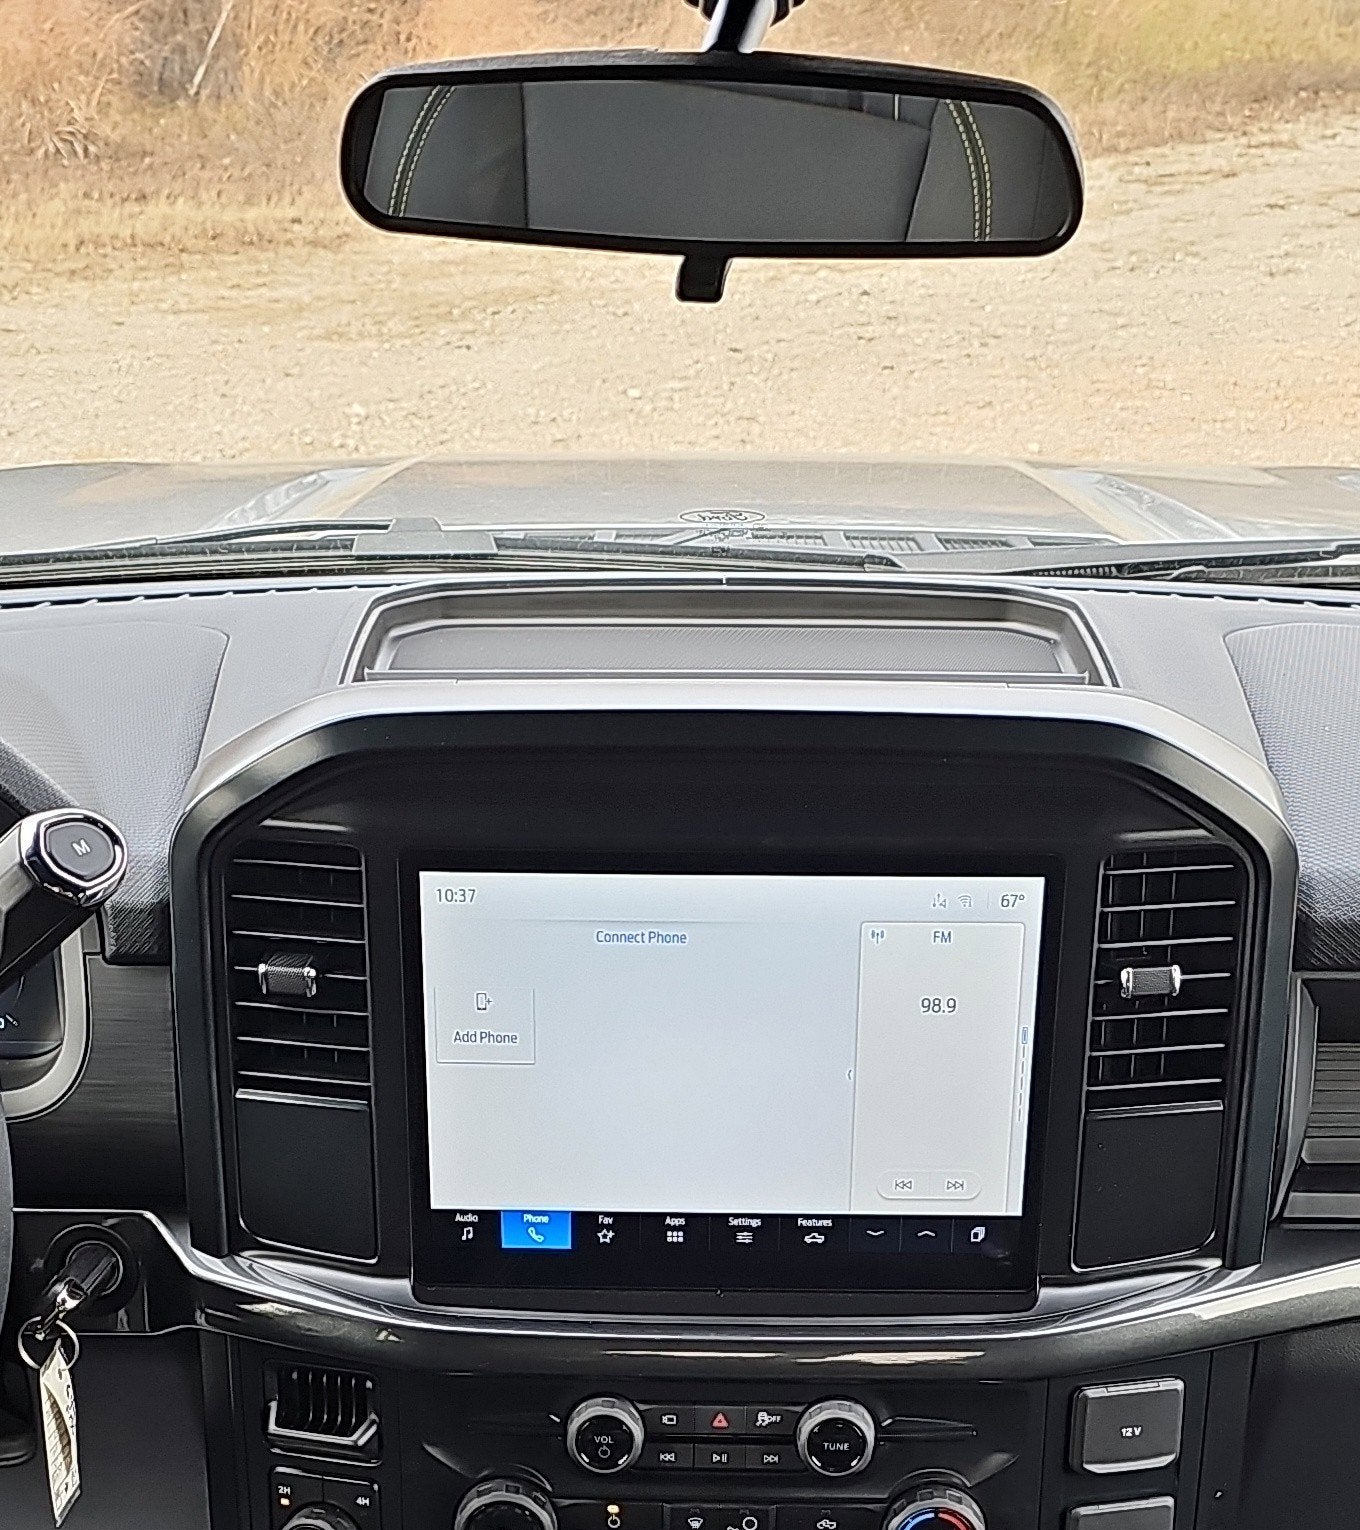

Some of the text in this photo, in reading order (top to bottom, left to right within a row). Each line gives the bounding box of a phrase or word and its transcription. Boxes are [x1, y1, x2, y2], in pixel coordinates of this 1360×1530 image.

[72, 839, 91, 856] M
[435, 888, 477, 903] 10:37
[1000, 894, 1025, 908] 67°
[595, 930, 687, 944] Connect Phone
[933, 930, 952, 944] FM
[920, 997, 957, 1014] 98.9
[453, 1030, 518, 1044] Add Phone
[454, 1213, 479, 1223] Audio
[522, 1213, 549, 1224] Phone
[598, 1214, 613, 1225] Fav
[665, 1215, 686, 1227] Apps
[728, 1215, 762, 1228] Settings
[797, 1217, 833, 1228] Features
[768, 1415, 782, 1423] OFF
[1121, 1426, 1142, 1437] 12 V
[593, 1435, 615, 1444] VOL
[823, 1442, 850, 1451] TUNE
[278, 1486, 291, 1495] 2H
[355, 1496, 370, 1506] 4H
